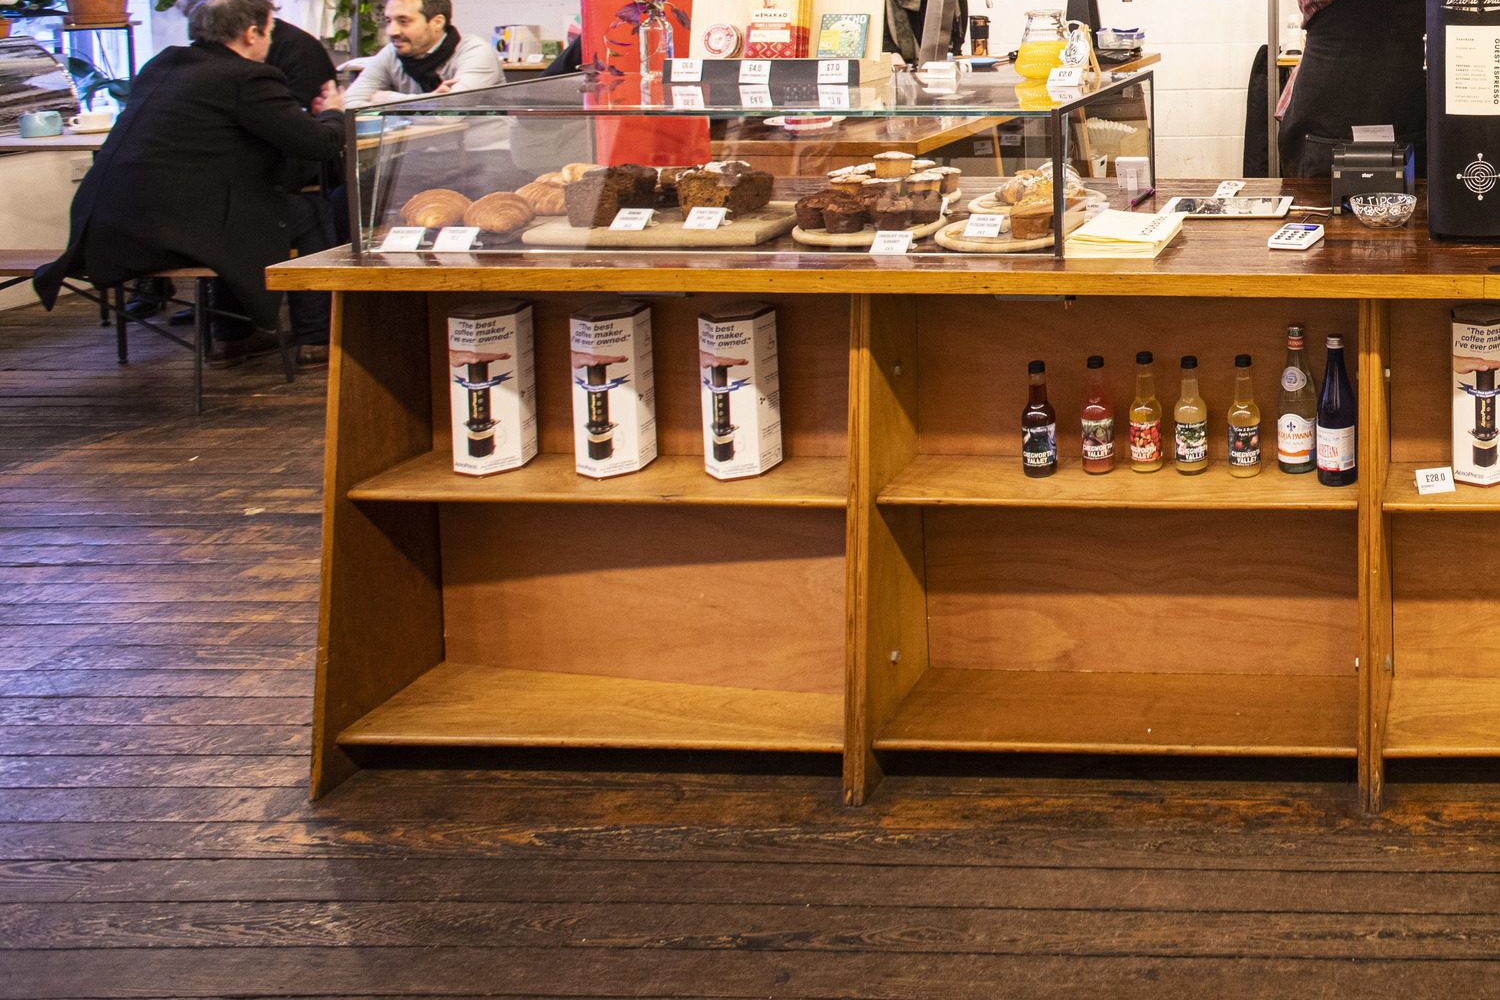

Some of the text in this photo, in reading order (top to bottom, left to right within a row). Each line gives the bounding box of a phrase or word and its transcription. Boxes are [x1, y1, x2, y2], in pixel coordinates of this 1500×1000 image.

[840, 14, 867, 24] TCHO
[748, 64, 762, 72] £4.0
[826, 63, 840, 72] £7.0
[475, 320, 496, 329] best
[593, 323, 613, 331] best
[454, 326, 507, 337] coffee maker
[575, 329, 623, 338] coffee maker
[715, 331, 743, 339] maker
[1461, 335, 1485, 343] coffee
[1455, 340, 1468, 348] I've
[1292, 431, 1313, 440] PANNA
[1087, 449, 1108, 457] VALLEY
[1236, 456, 1258, 464] VALLEY
[1425, 472, 1446, 483] £28.0
